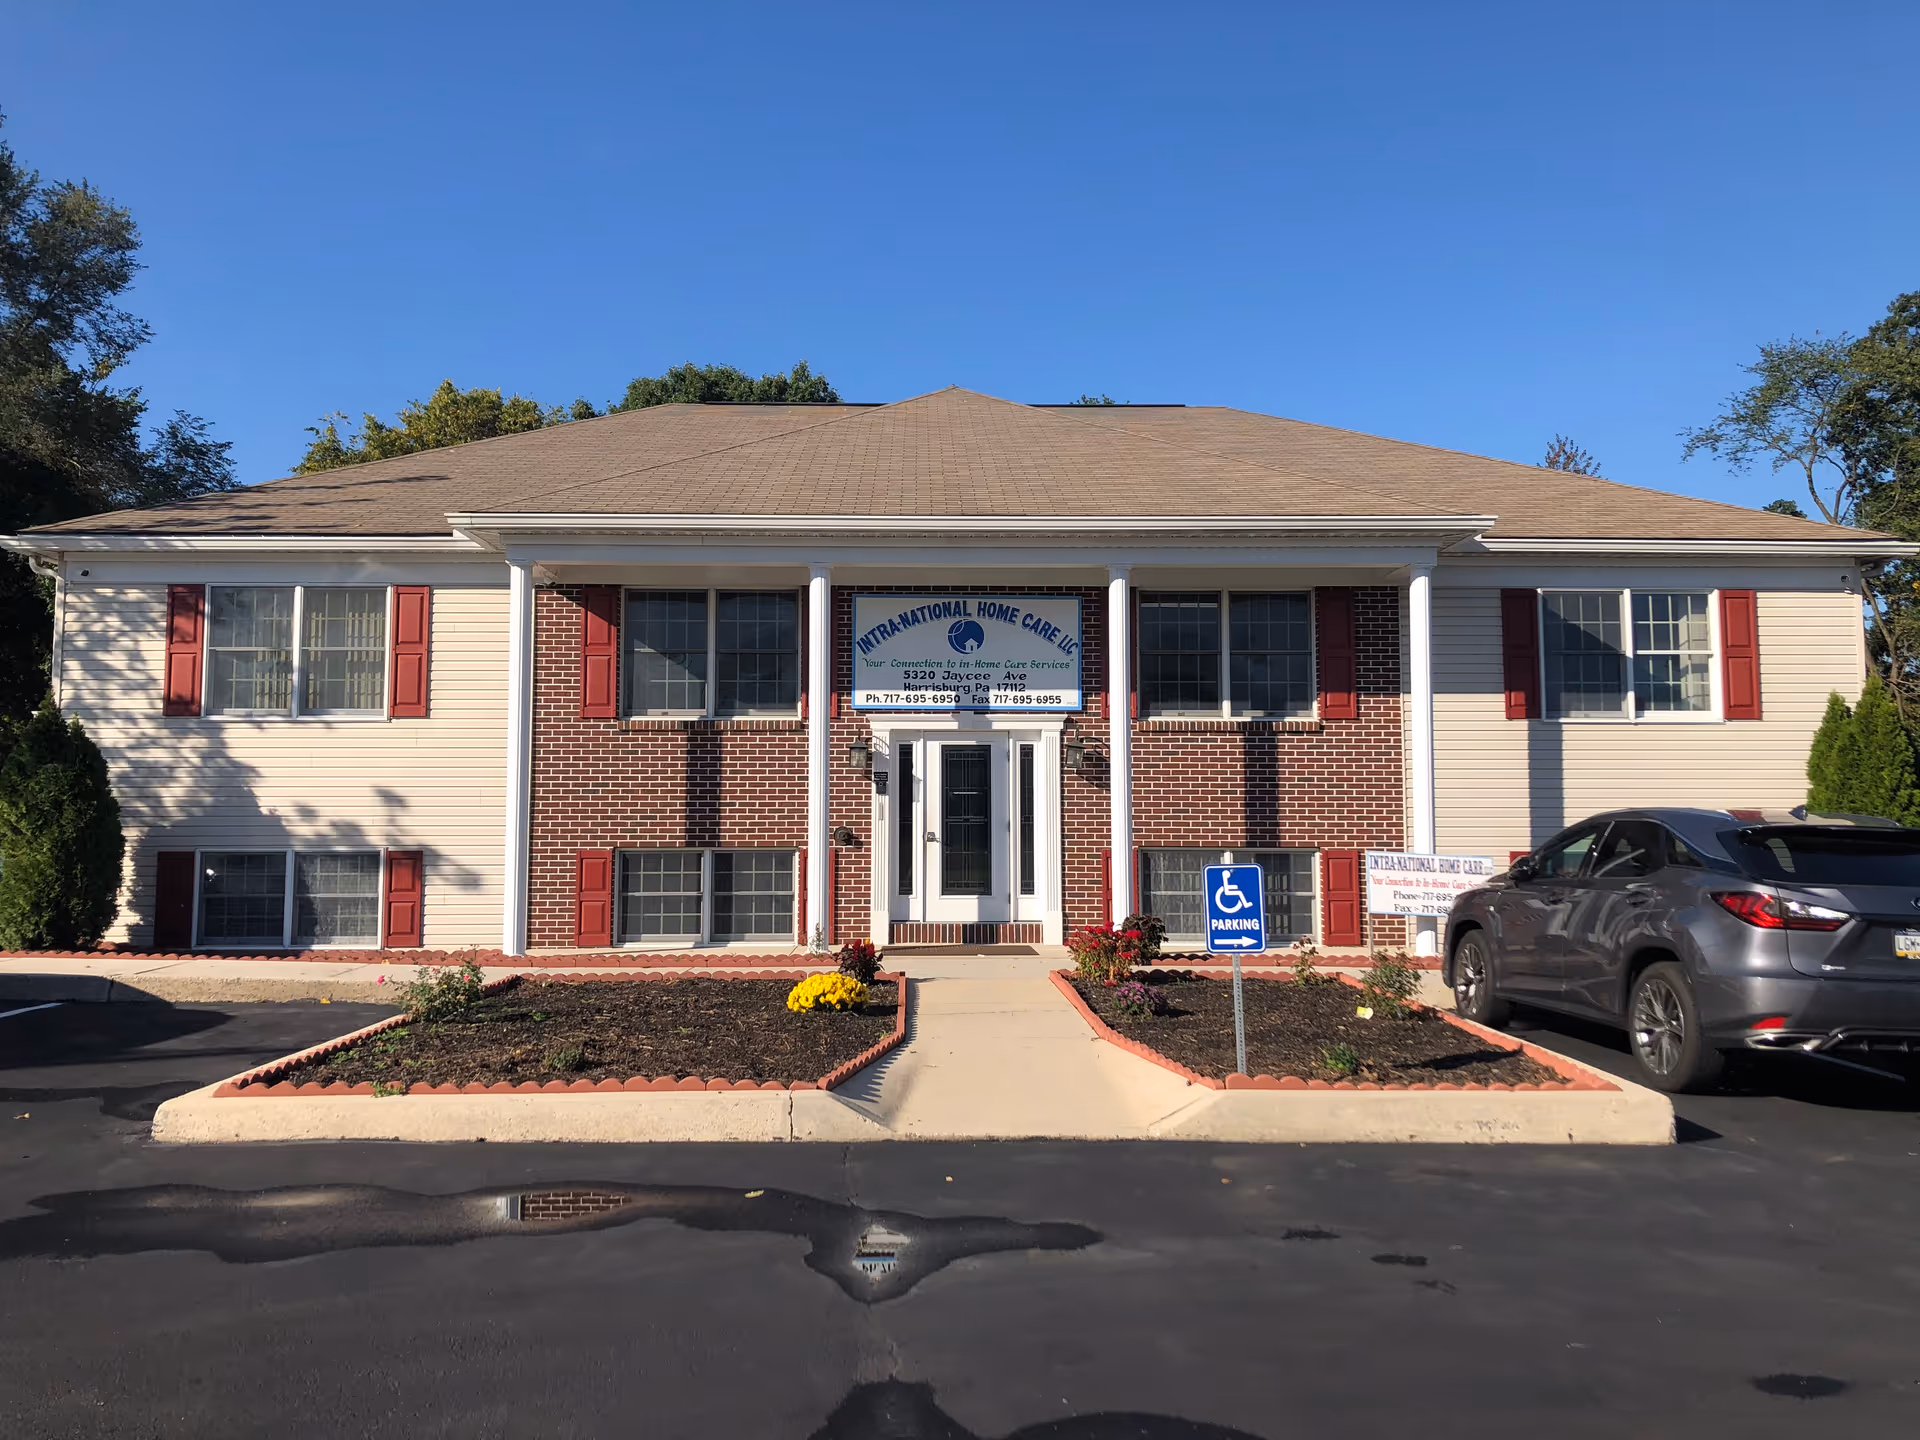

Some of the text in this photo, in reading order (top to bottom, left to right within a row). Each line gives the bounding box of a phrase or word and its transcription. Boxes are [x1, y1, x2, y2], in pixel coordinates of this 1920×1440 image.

[856, 599, 972, 655] INTRA-NATIONAL
[977, 600, 1021, 626] HOME
[1057, 633, 1079, 656] LLC
[890, 658, 943, 668] Connection
[946, 659, 956, 668] to
[958, 659, 1001, 669] in-Home
[1004, 659, 1028, 669] Care
[903, 670, 1027, 683] 5320 Jaycee Ave
[975, 683, 990, 693] Pa
[996, 683, 1026, 692] 17112
[972, 694, 991, 704] Fax
[993, 694, 1062, 704] 717-695-6955
[1438, 858, 1461, 874] HOME
[1385, 876, 1414, 887] Connection
[1394, 903, 1412, 913] Fax
[1211, 918, 1260, 931] PARKING
